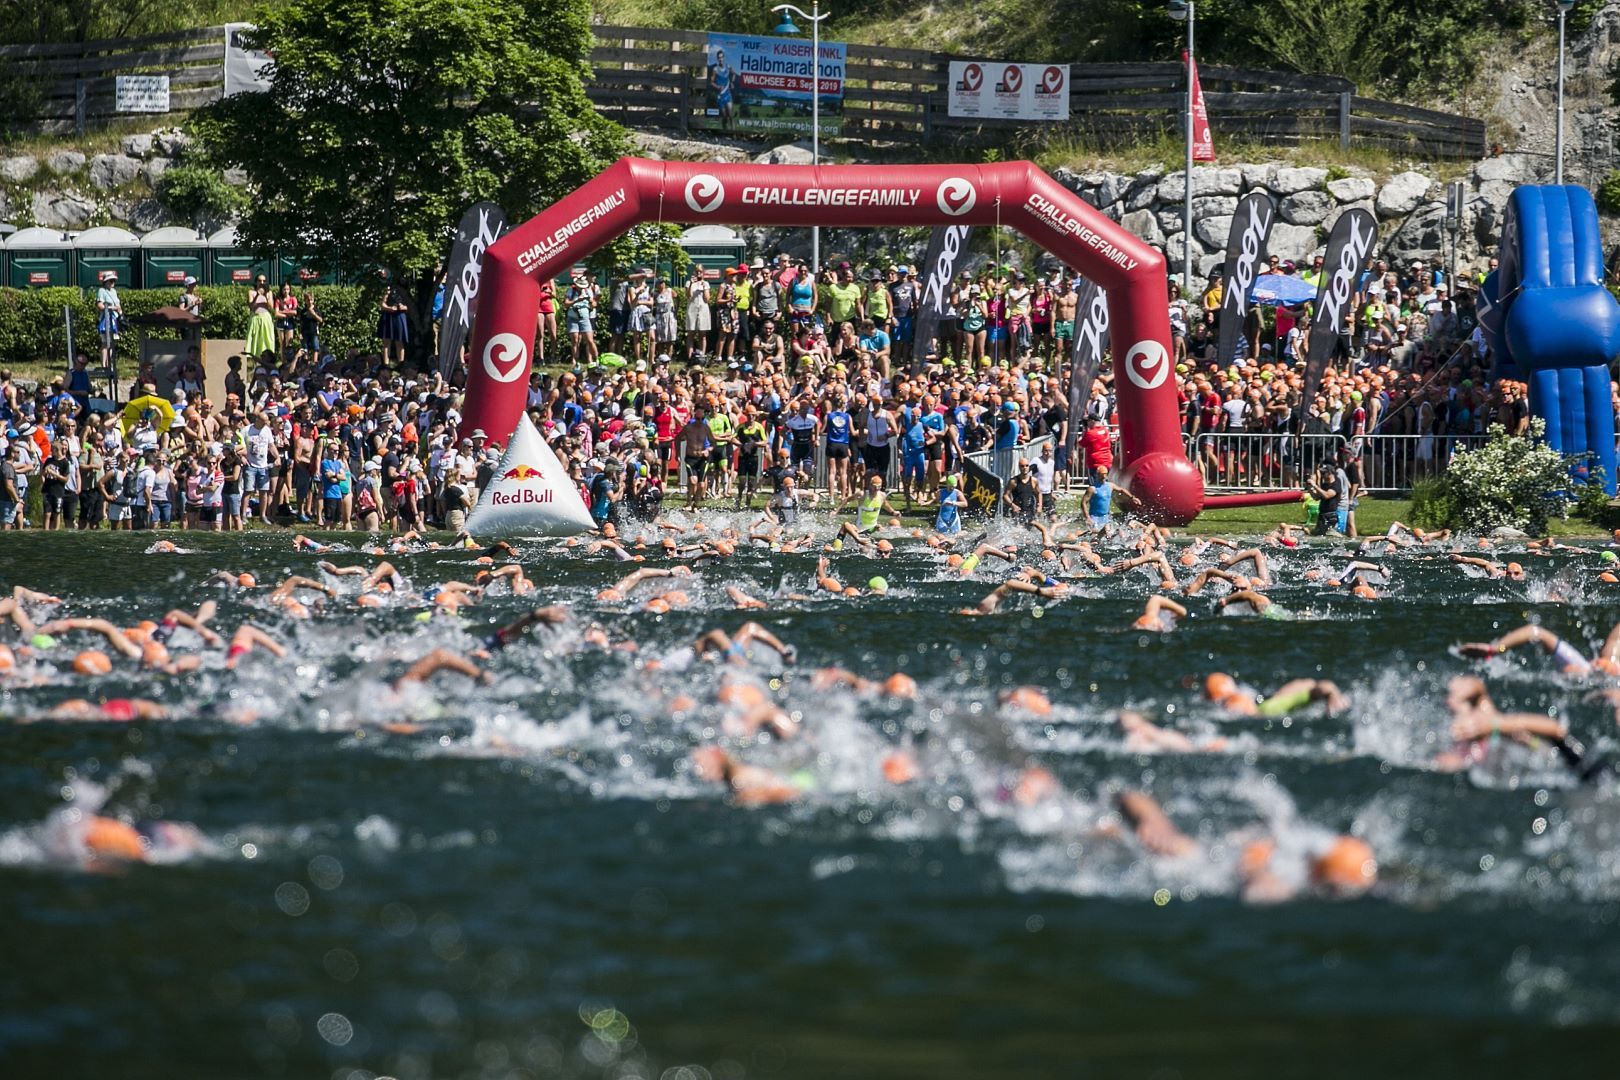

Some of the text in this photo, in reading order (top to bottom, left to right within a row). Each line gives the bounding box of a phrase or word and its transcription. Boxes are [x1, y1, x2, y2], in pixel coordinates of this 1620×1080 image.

[740, 54, 842, 77] Halbmarathon
[743, 75, 785, 87] WALCHSEE
[820, 82, 838, 91] 2019
[742, 187, 921, 206] CHALLENGEFAMILY
[517, 188, 627, 268] CHALLENGEFAMILY
[1028, 193, 1139, 271] CHALLENGEFAMILY
[492, 489, 553, 505] Red Bull
